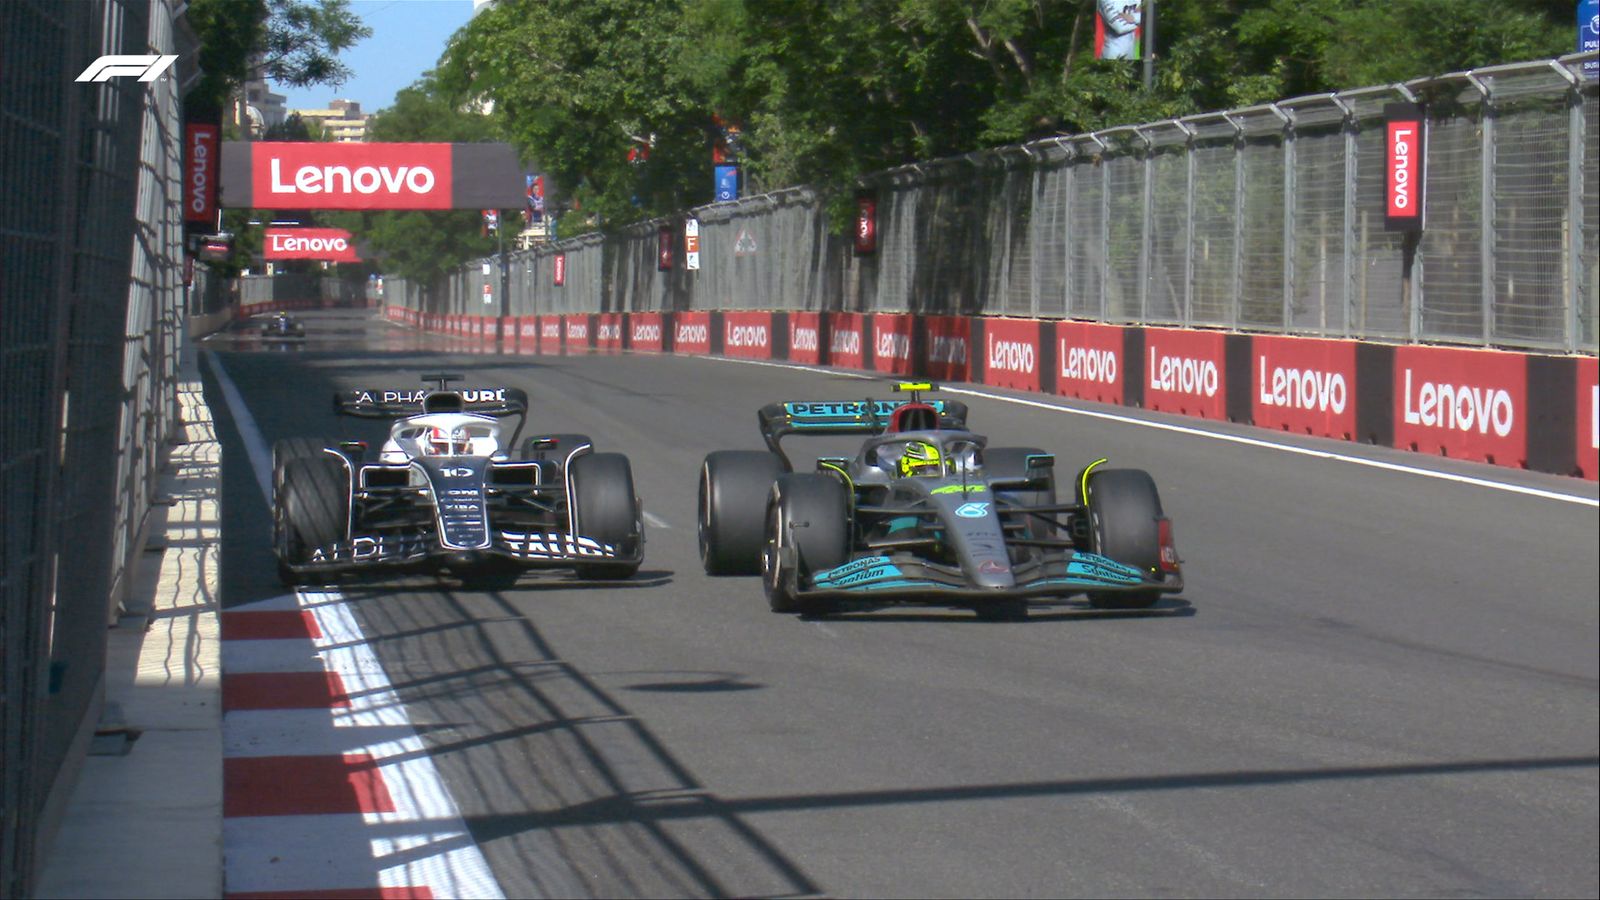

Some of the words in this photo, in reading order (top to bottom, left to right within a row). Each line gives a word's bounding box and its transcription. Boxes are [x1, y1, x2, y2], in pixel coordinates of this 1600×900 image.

[192, 131, 211, 213] Lenovo
[270, 158, 435, 194] Lenovo
[1394, 129, 1412, 209] Lenovo
[272, 234, 348, 252] Lenovo
[687, 237, 697, 251] F
[597, 323, 621, 340] Lenovo
[632, 321, 661, 340] Lenovo
[674, 321, 707, 343] Lenovo
[727, 320, 768, 347] Lenovo
[791, 323, 818, 350] Lenovo
[830, 325, 860, 355] Lenovo
[876, 326, 910, 360] Lenovo
[928, 329, 967, 365] Lenovo
[988, 332, 1034, 373] Lenovo
[1061, 338, 1117, 384] Lenovo
[1150, 346, 1219, 397] Lenovo
[1260, 355, 1347, 414] Lenovo
[1404, 368, 1514, 437] Lenovo
[439, 467, 475, 478] 10
[827, 556, 881, 578] PETRONAS
